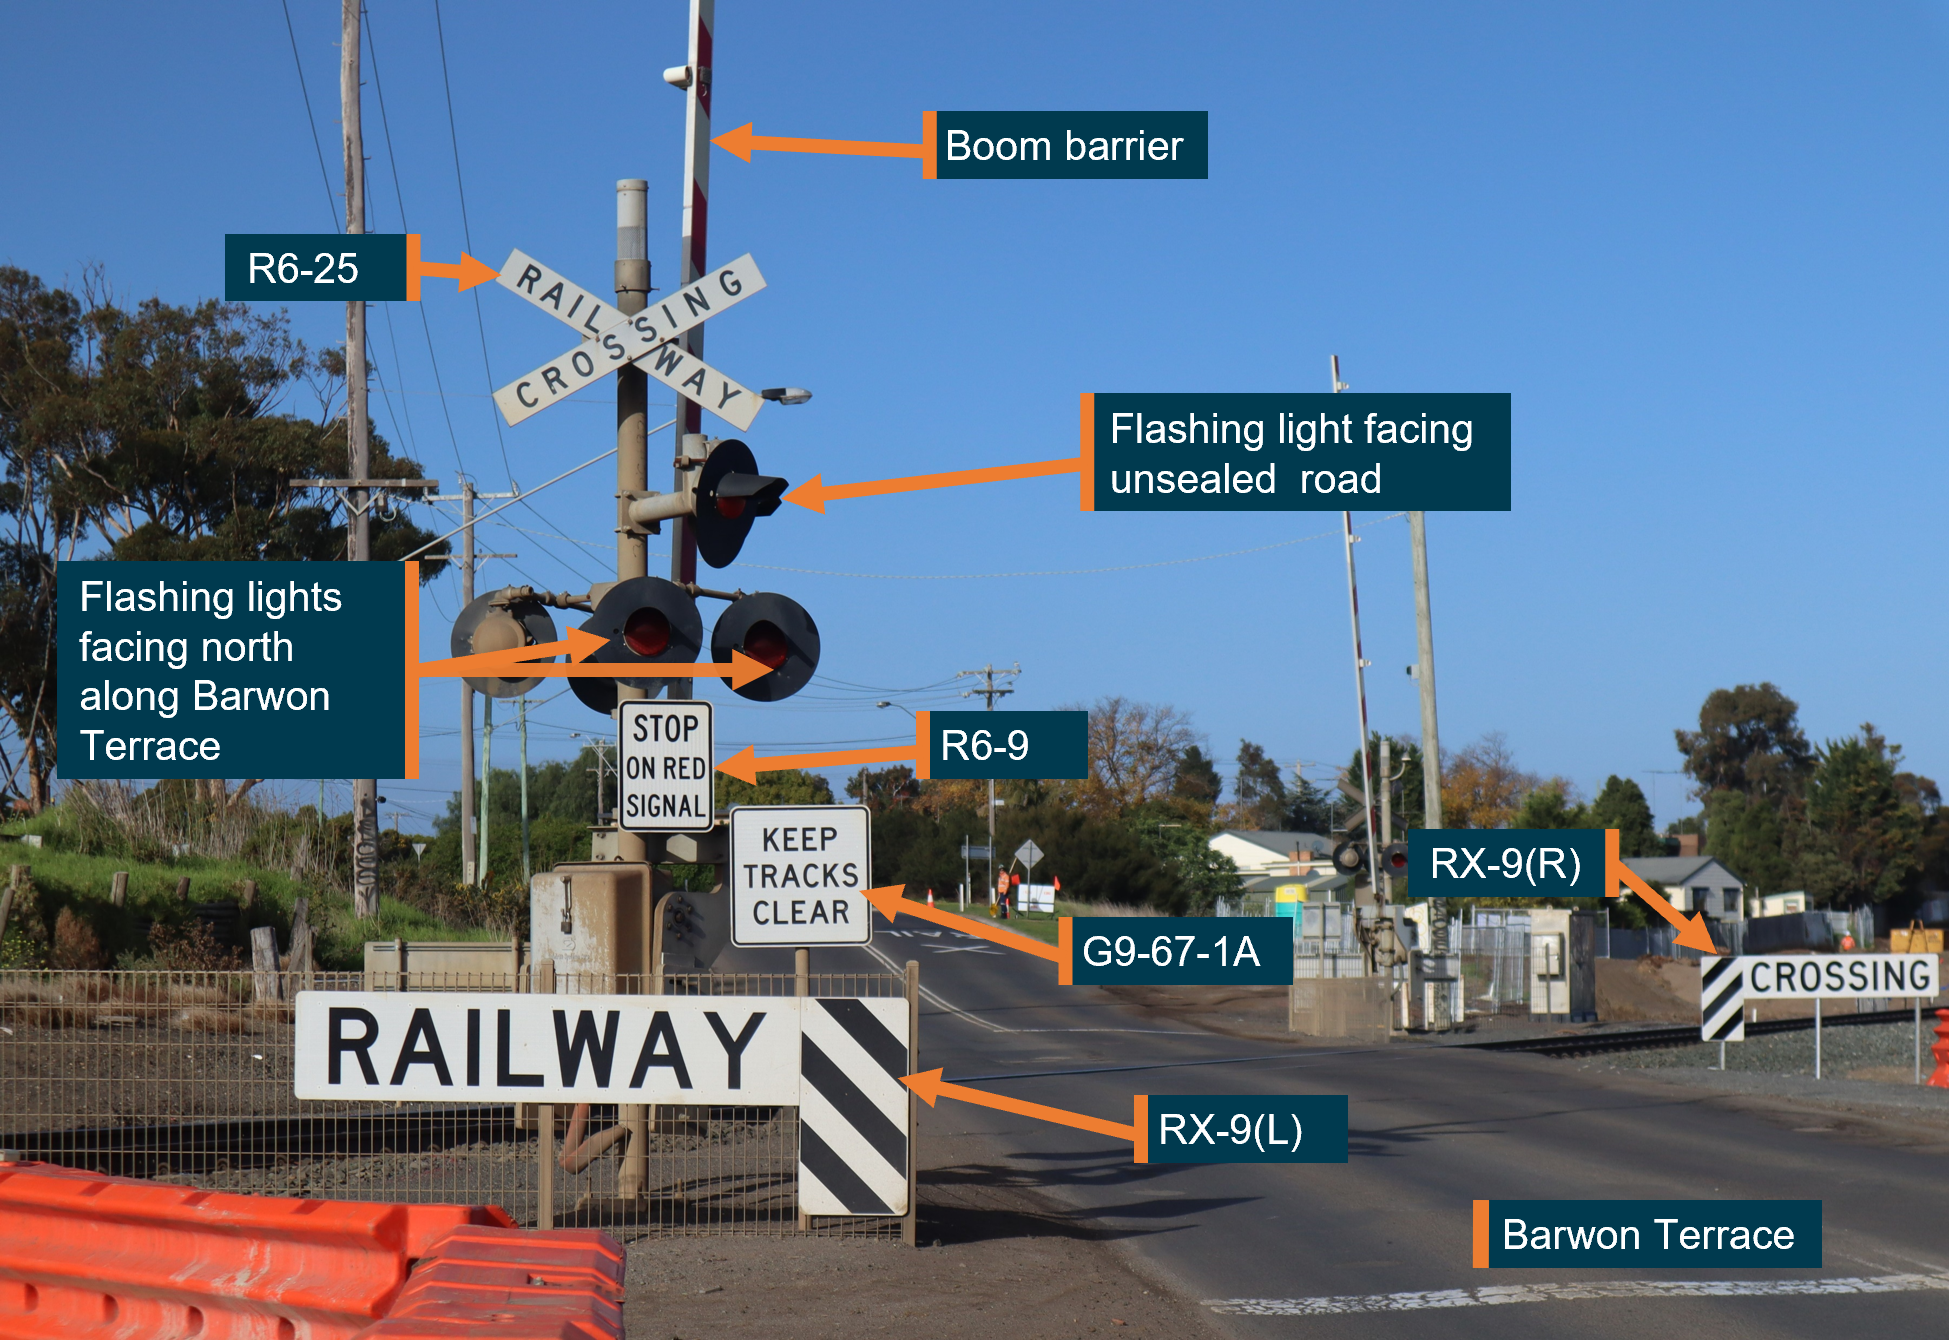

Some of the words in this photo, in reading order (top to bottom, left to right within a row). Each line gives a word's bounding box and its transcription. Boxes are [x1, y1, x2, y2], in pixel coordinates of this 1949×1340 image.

[516, 269, 743, 408] CROSSING
[634, 714, 698, 742] STOP
[627, 756, 654, 779] ON
[664, 757, 705, 779] RED
[627, 794, 706, 817] SIGNAL
[764, 827, 837, 851] KEEP
[744, 863, 858, 888] TRACKS
[754, 900, 848, 925] CLEAR
[1751, 960, 1930, 992] CROSSING
[328, 1006, 767, 1090] RAILWAY
